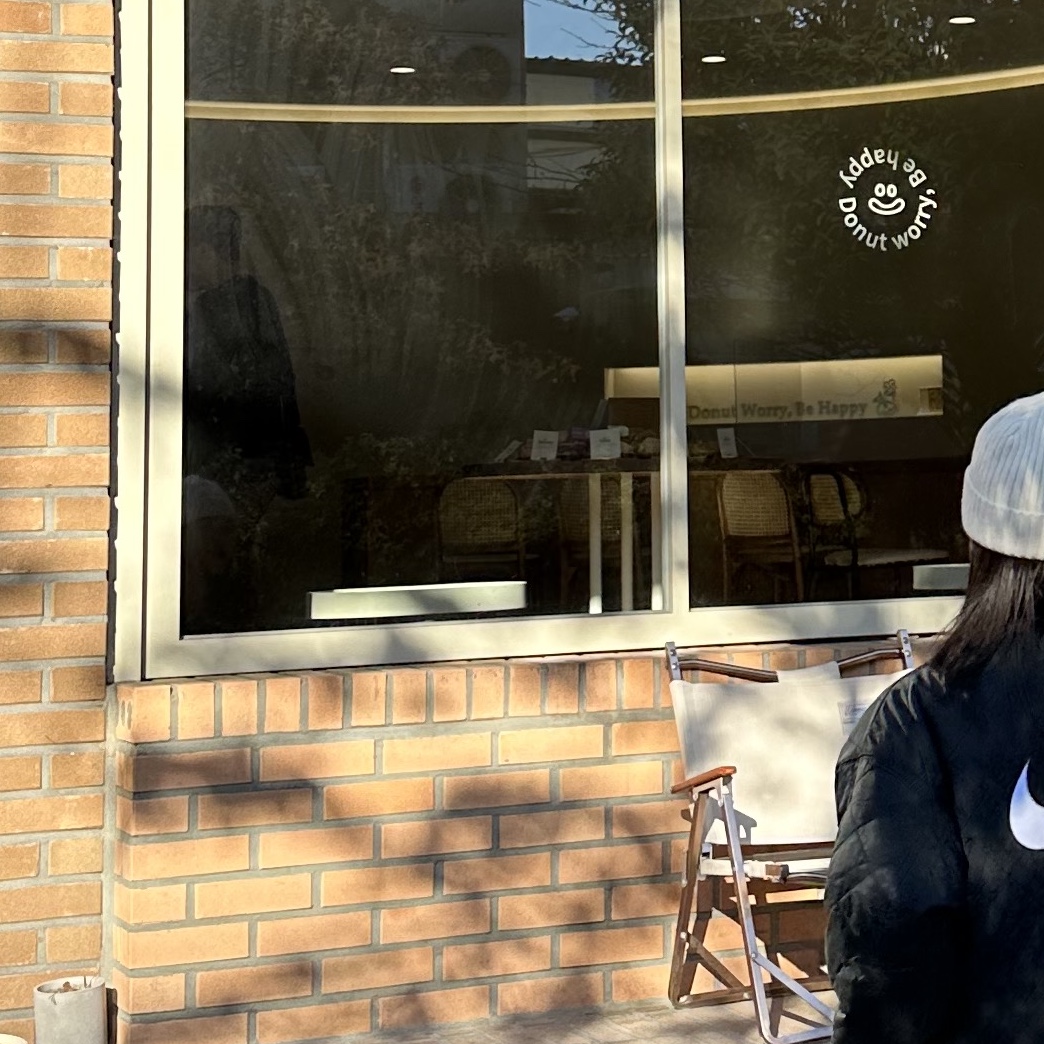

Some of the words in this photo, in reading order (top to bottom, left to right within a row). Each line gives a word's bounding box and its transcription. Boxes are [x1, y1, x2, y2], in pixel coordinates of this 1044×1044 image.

[839, 147, 899, 189] happy
[902, 158, 928, 188] Be
[839, 197, 887, 251] Donut
[891, 188, 938, 250] worry,
[688, 404, 737, 420] Donut
[741, 402, 793, 419] Worry,
[795, 401, 813, 417] Be
[818, 400, 868, 418] Happy
